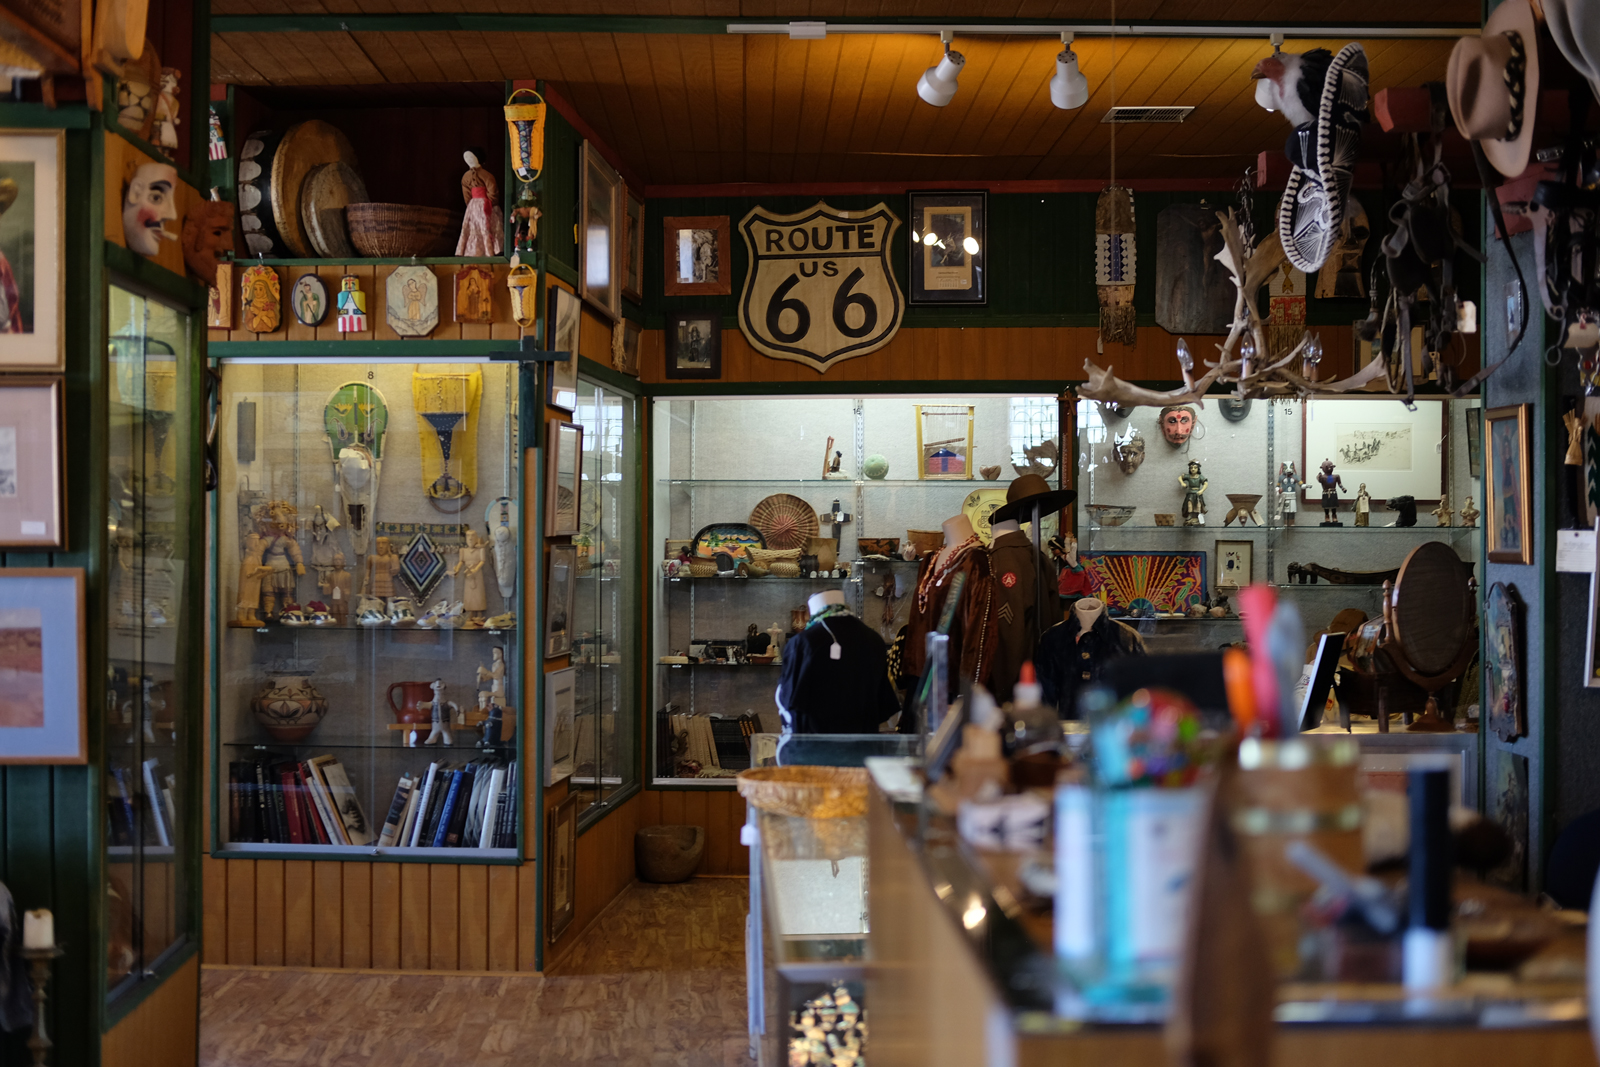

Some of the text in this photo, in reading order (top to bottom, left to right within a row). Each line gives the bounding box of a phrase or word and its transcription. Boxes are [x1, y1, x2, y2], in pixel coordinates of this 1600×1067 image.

[765, 224, 875, 252] ROUTE
[800, 261, 839, 278] US
[765, 267, 878, 344] 66
[367, 370, 375, 380] 8
[1284, 407, 1293, 416] 15
